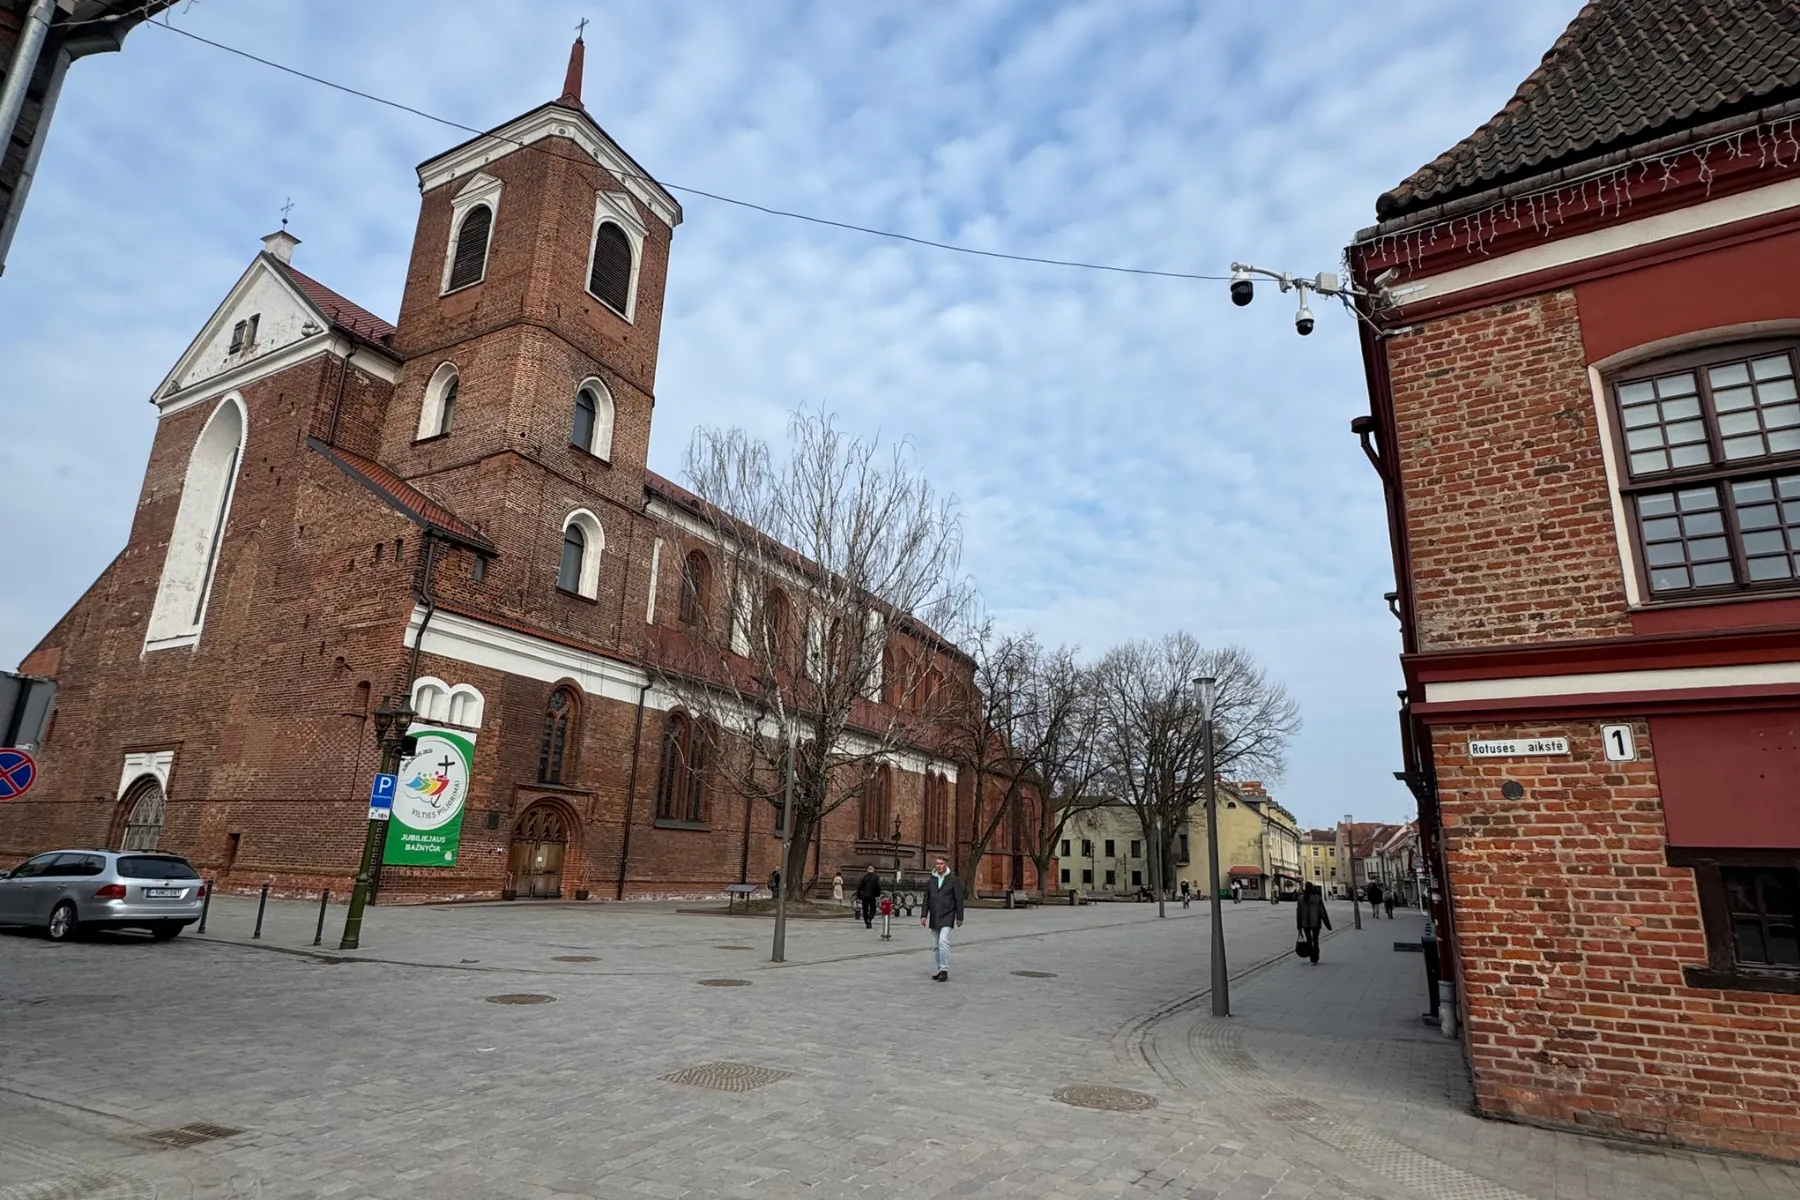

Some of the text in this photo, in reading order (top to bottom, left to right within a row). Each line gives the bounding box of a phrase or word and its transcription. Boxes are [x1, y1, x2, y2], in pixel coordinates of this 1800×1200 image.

[1612, 729, 1625, 756] 1
[378, 776, 392, 794] P
[411, 807, 437, 819] VILTIES
[401, 834, 446, 843] JUBILIEJAUS
[405, 843, 440, 852] BAŽNYČIA
